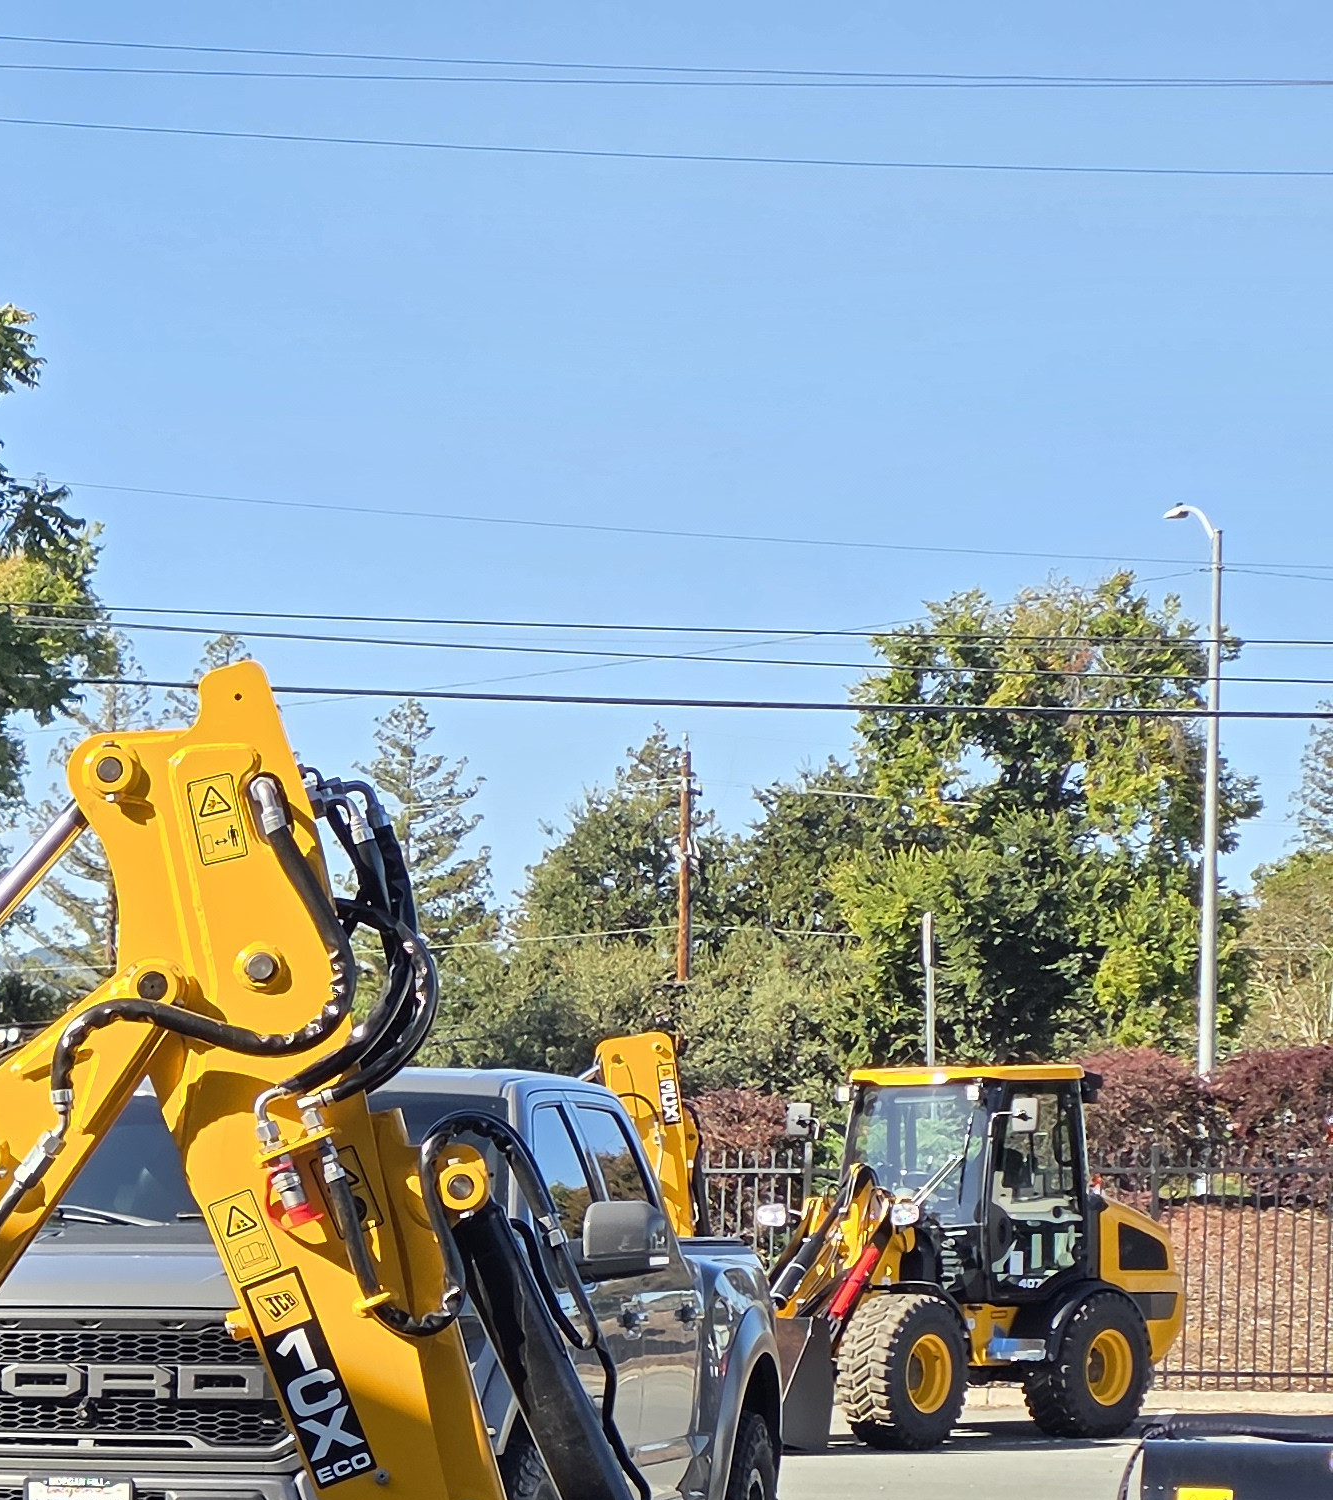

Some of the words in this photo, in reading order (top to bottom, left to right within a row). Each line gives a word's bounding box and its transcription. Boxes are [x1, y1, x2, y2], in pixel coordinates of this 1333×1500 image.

[264, 1291, 297, 1319] JCB
[275, 1327, 365, 1463] 1CX
[315, 1451, 372, 1484] ECO
